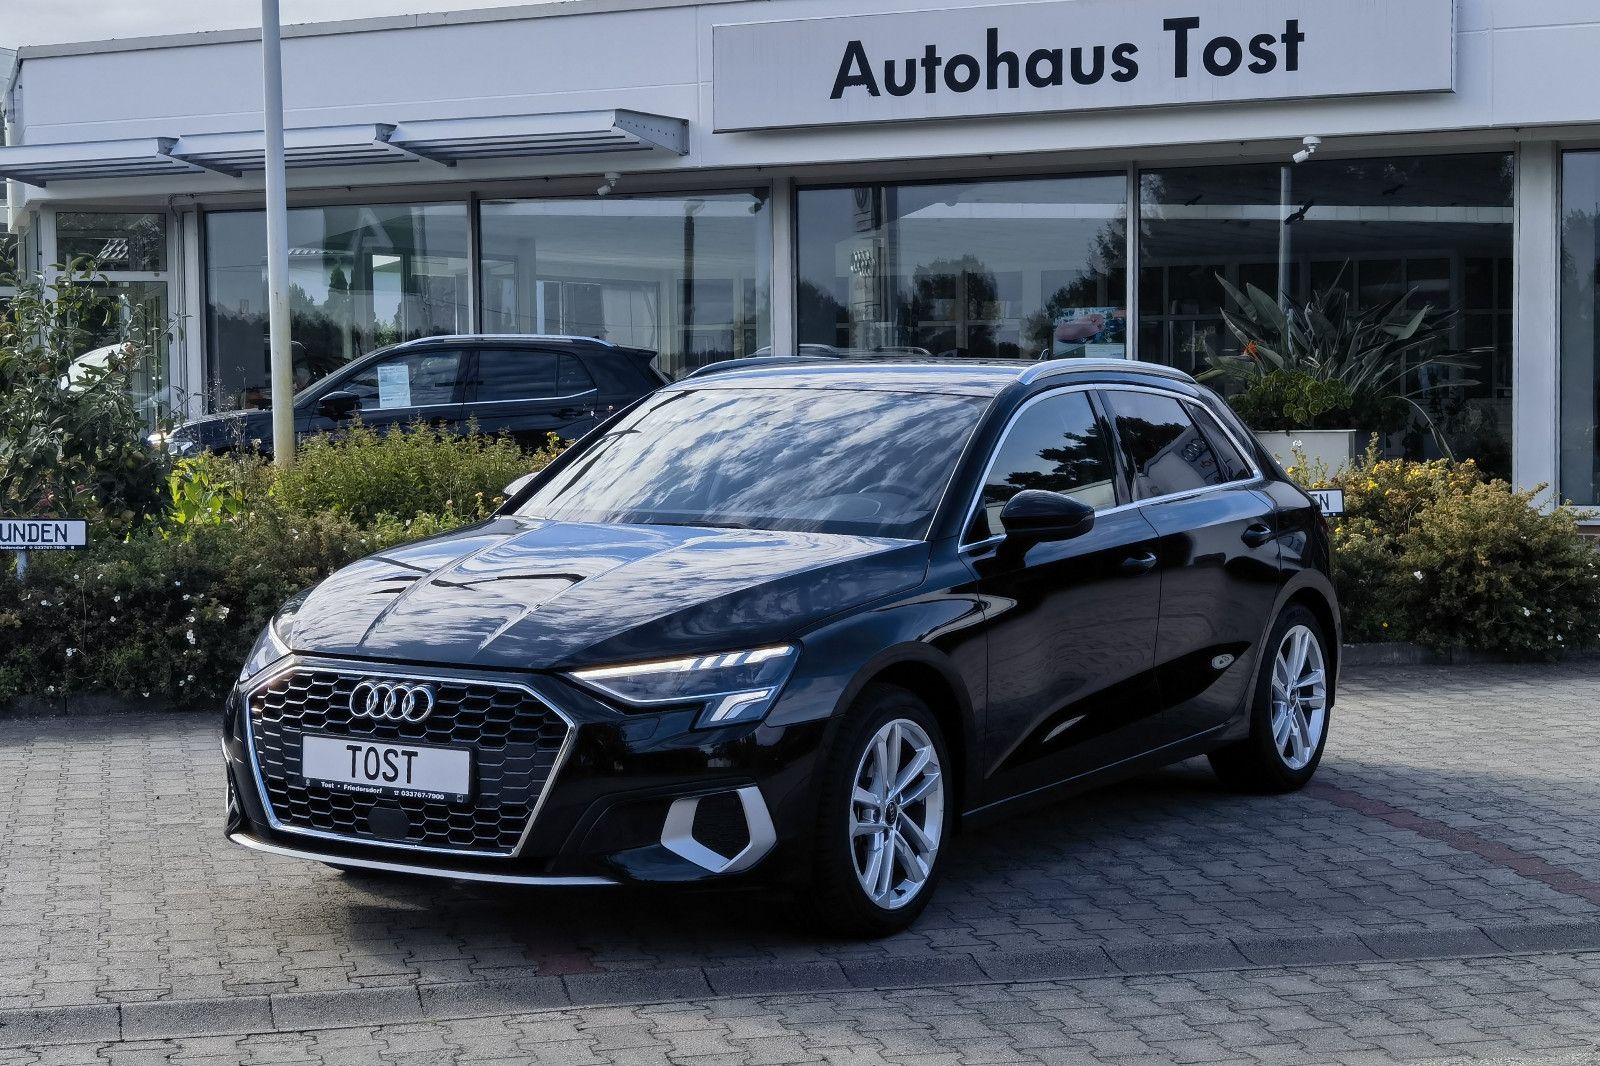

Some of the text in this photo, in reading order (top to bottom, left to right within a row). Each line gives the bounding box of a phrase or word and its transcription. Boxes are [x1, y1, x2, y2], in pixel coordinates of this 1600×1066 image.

[830, 18, 1305, 100] Autohaus Tost
[0, 522, 68, 543] UNDEN
[346, 744, 419, 784] TOST
[343, 784, 383, 794] Friedersdorf
